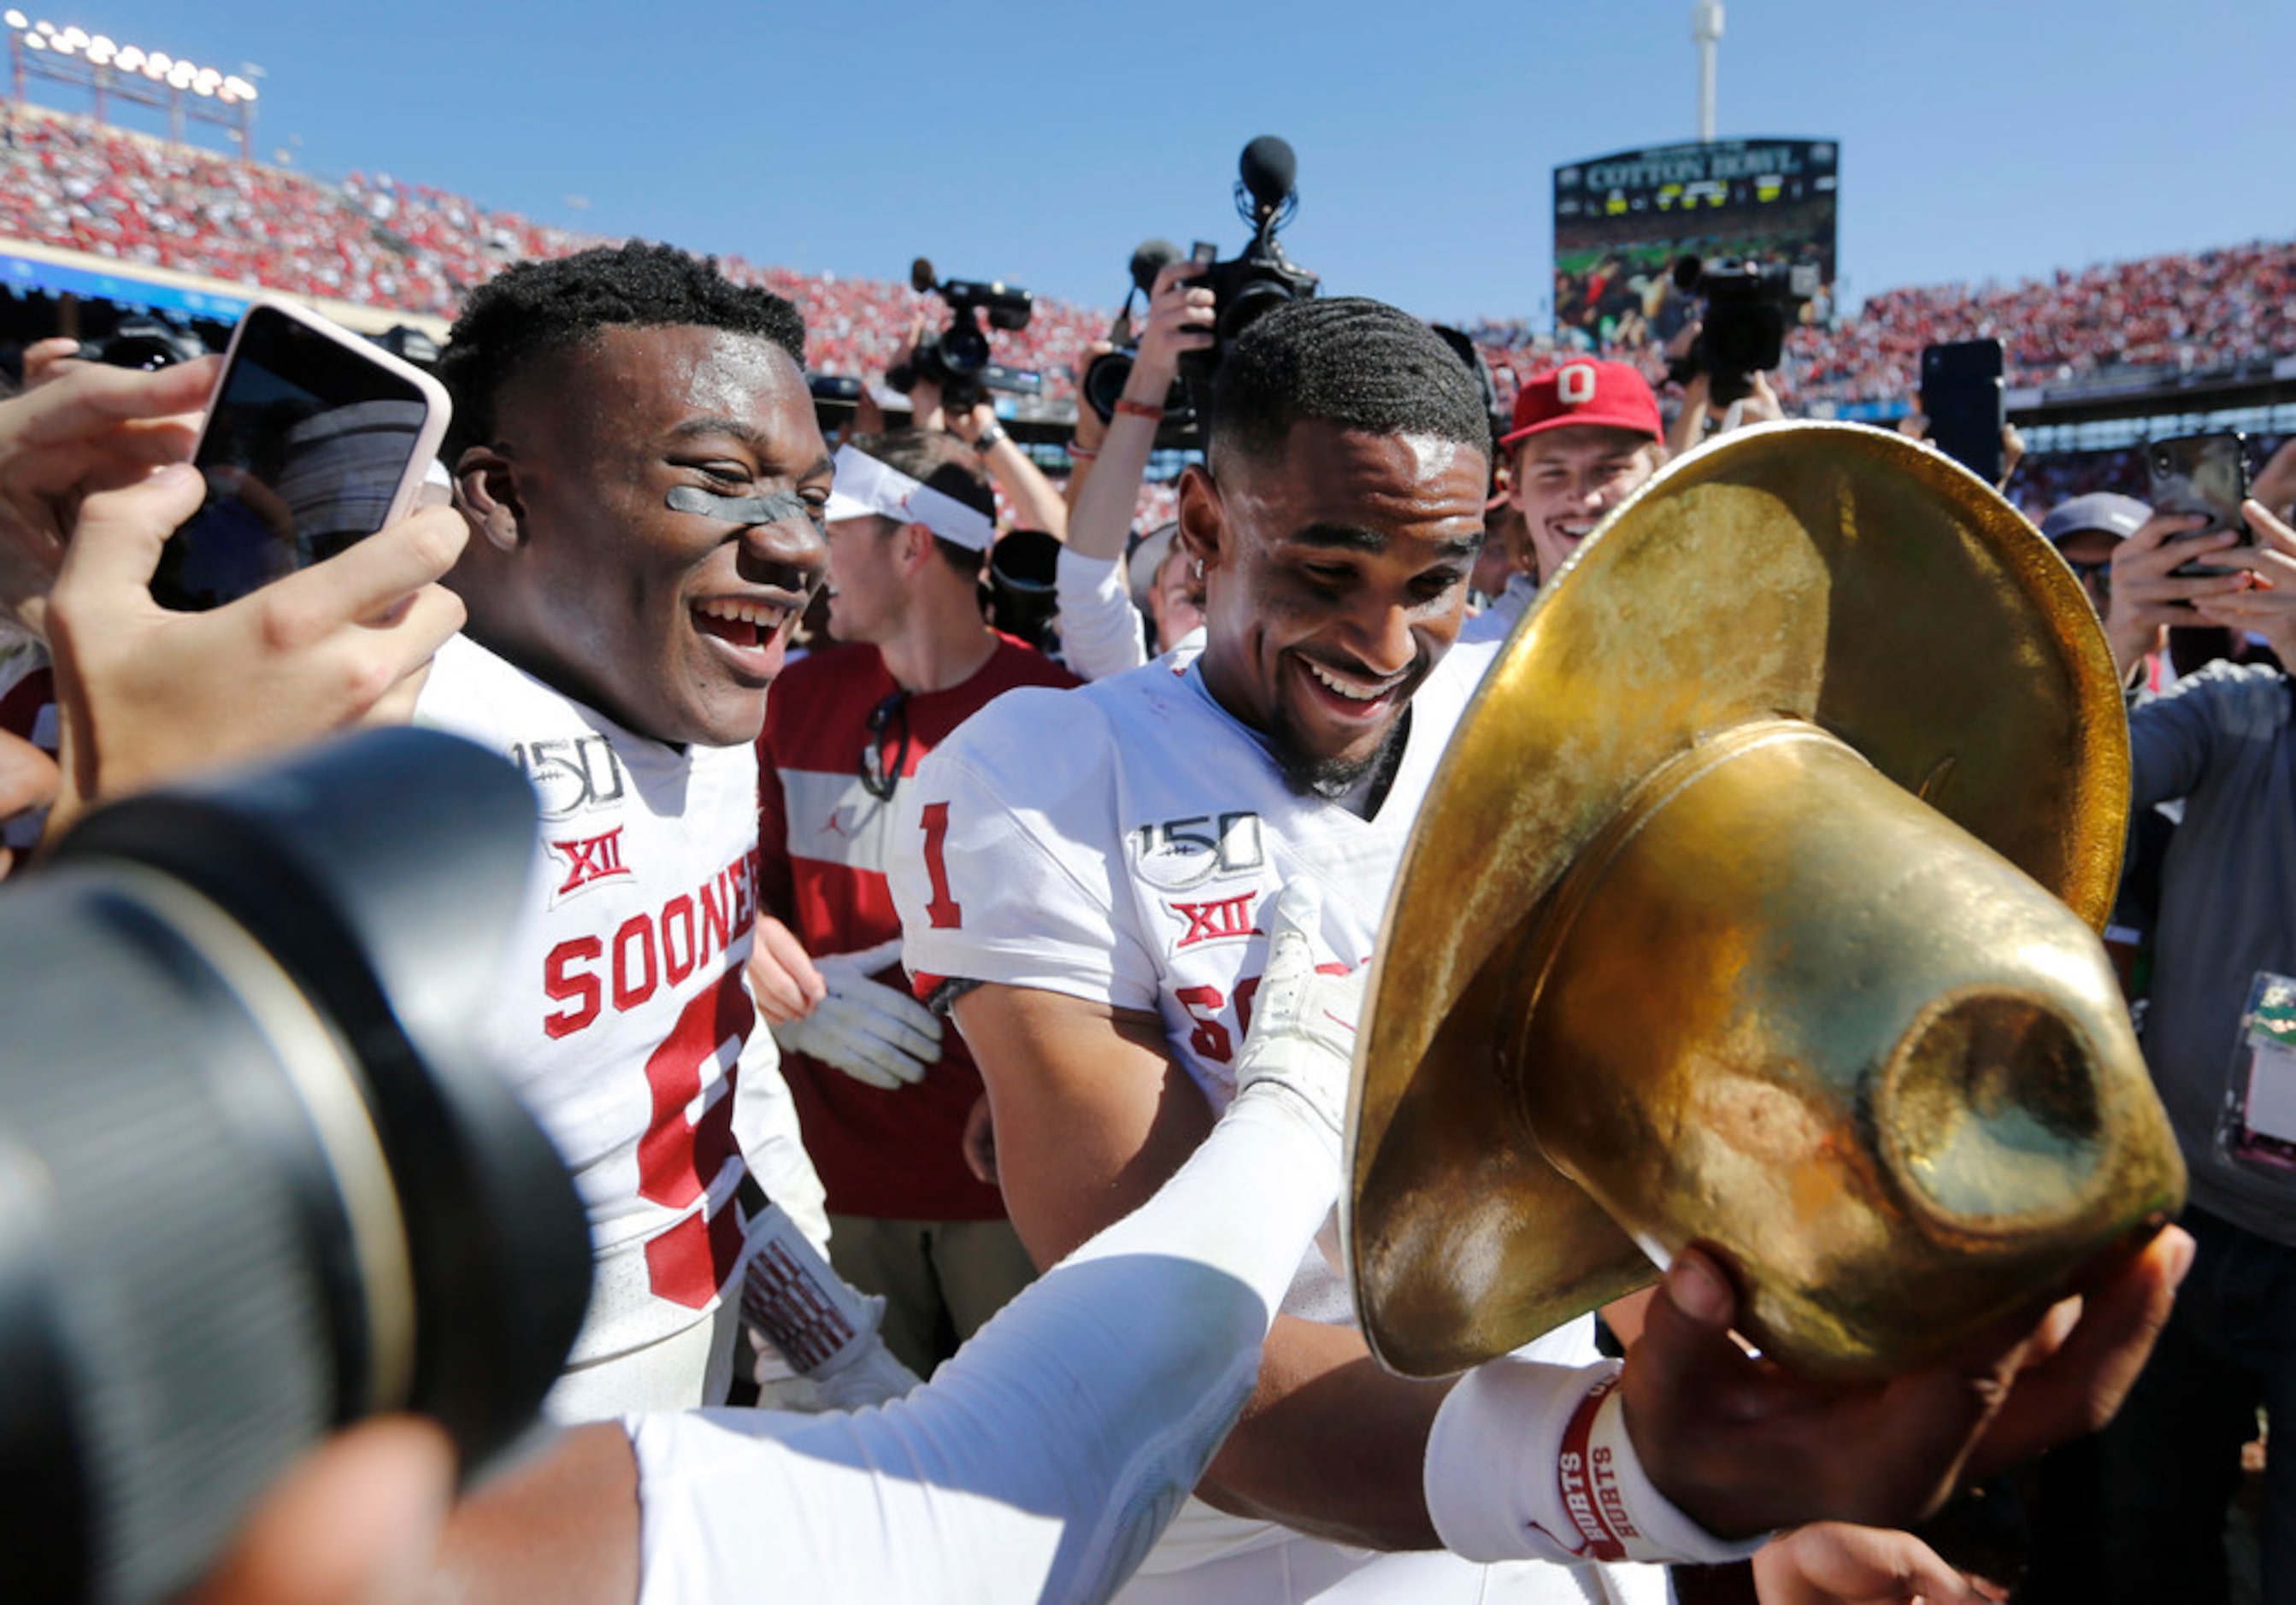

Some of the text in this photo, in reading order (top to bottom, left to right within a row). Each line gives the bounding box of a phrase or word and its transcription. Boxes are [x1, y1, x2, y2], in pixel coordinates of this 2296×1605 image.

[1557, 364, 1595, 404] O
[551, 824, 631, 896] XII
[919, 801, 963, 930] 1
[1139, 811, 1264, 886] 150
[1169, 891, 1265, 949] XII
[1592, 1445, 1641, 1539] HURTS
